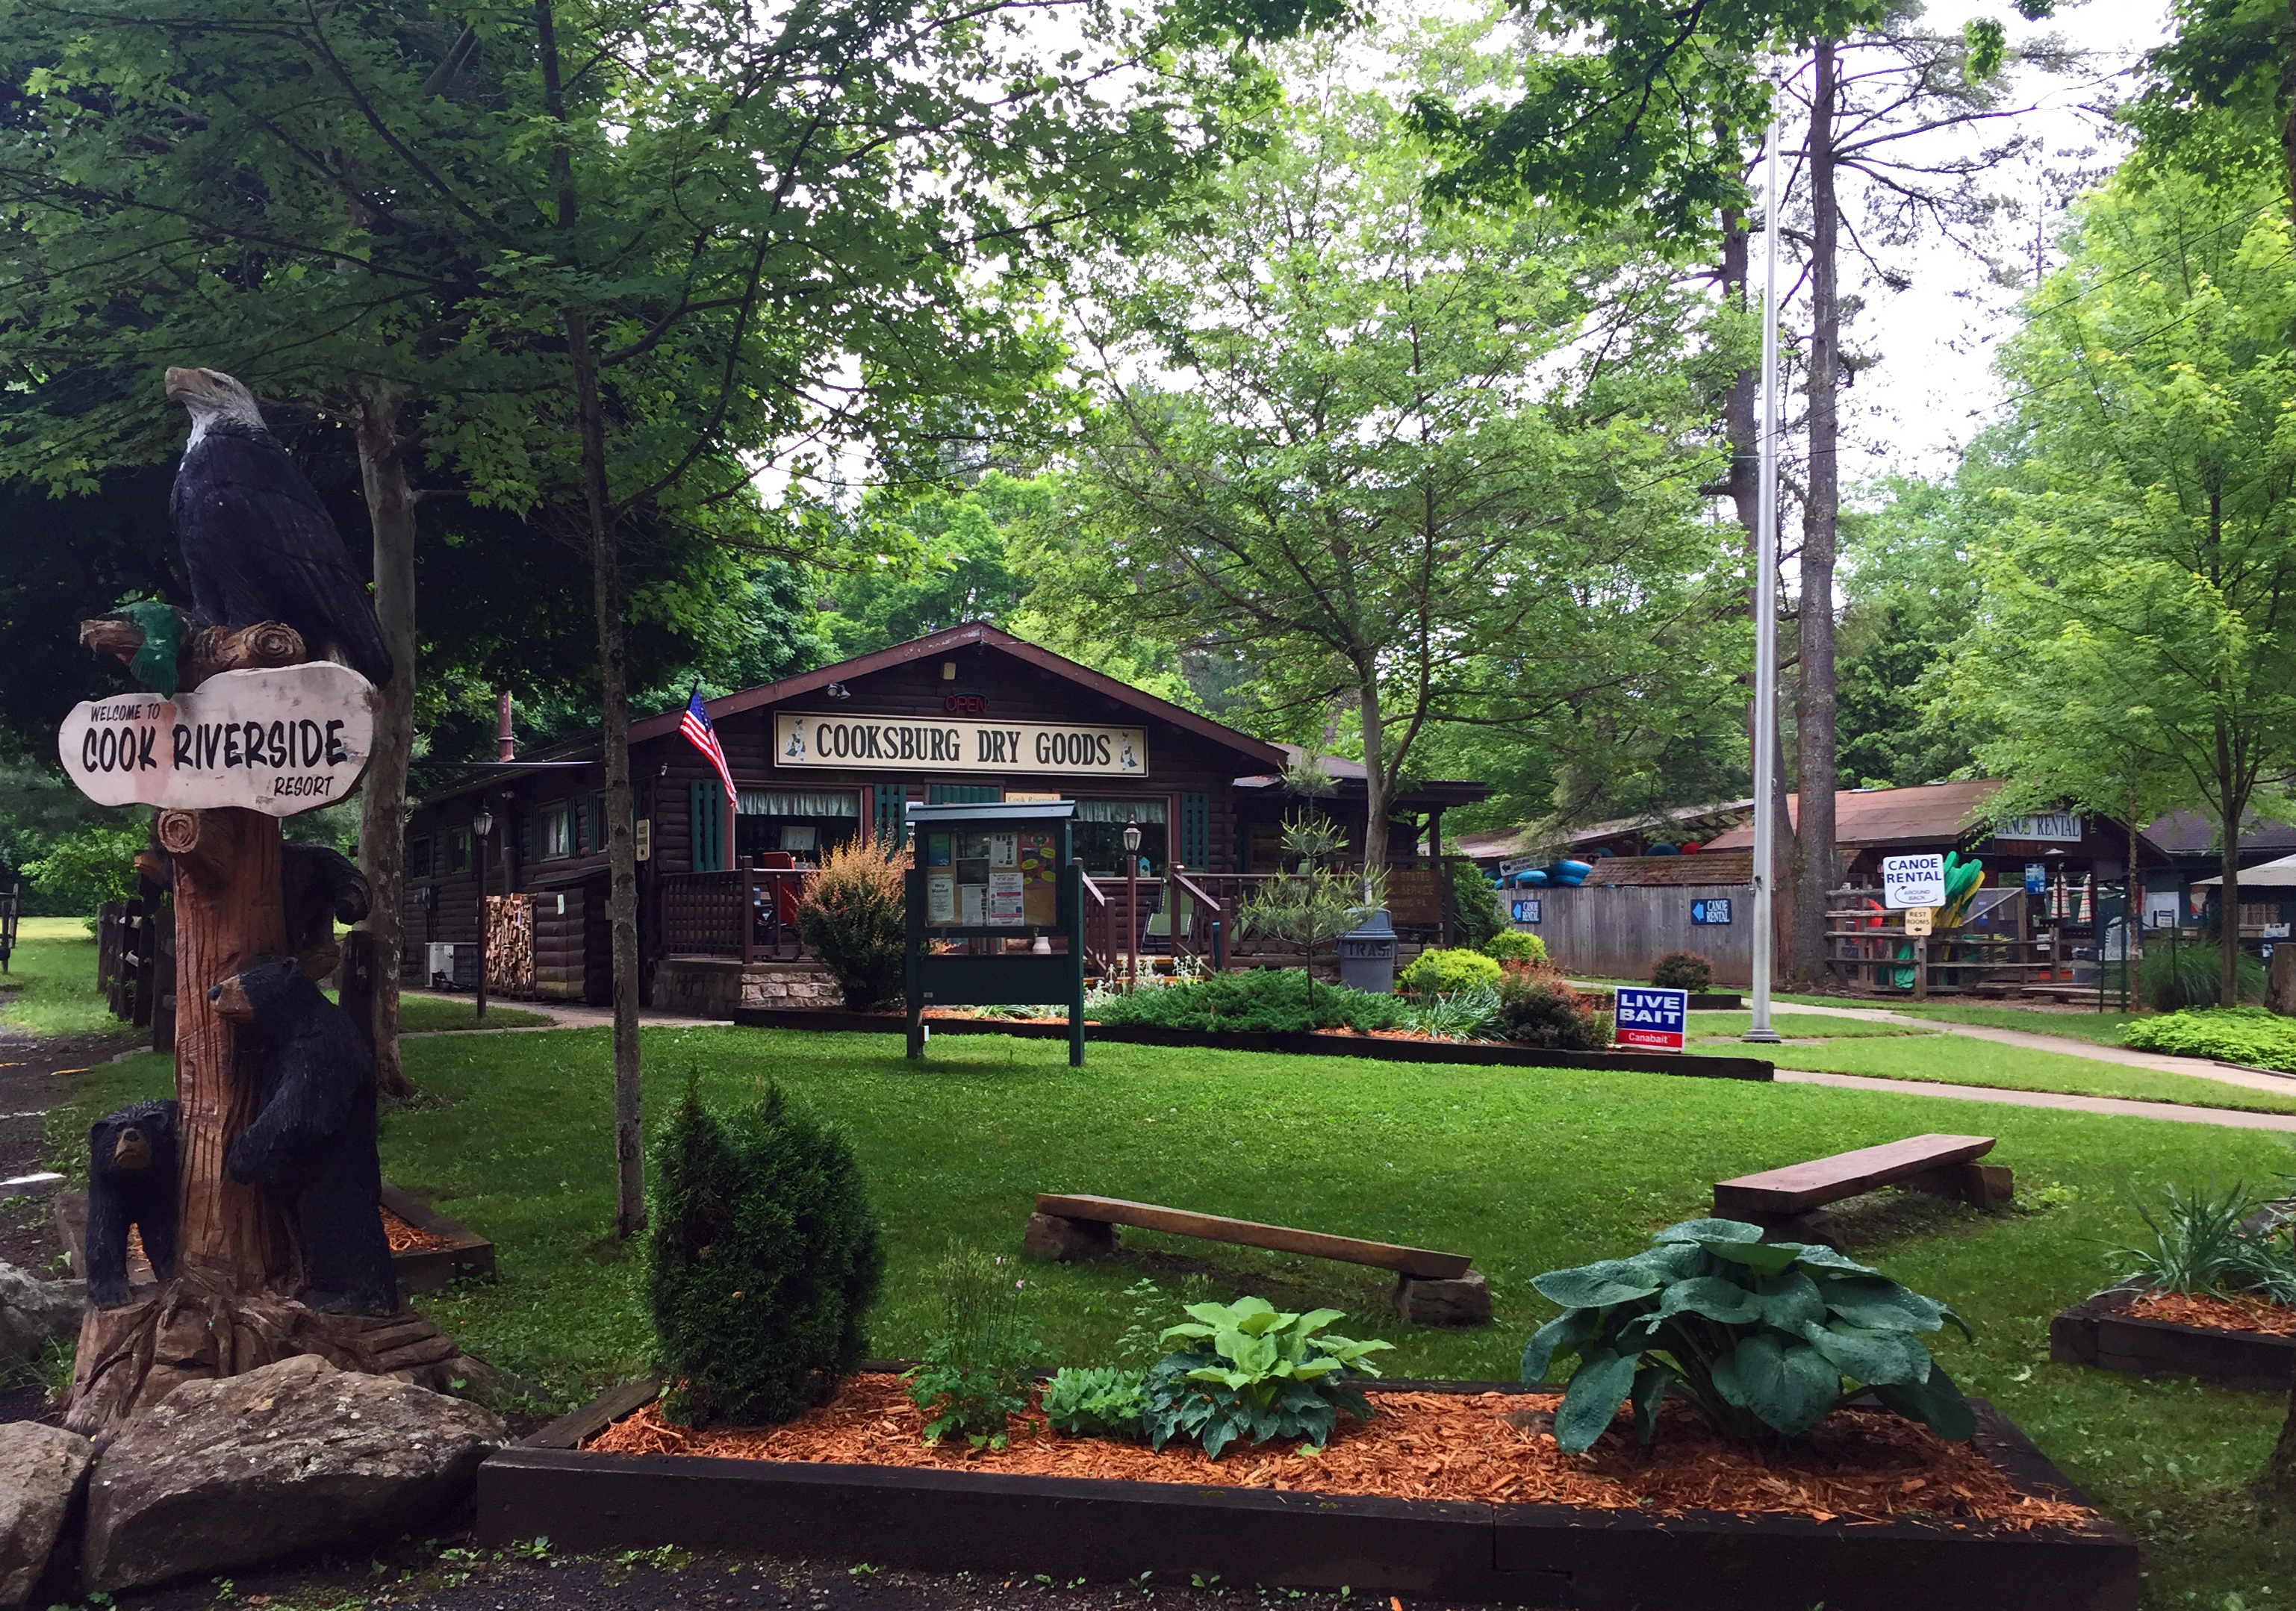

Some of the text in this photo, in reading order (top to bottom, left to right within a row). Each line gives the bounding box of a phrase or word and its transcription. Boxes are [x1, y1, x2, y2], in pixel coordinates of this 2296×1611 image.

[945, 695, 987, 713] OPEN
[90, 702, 161, 723] WELCOME TO
[81, 719, 348, 773] COOK RIVERSIDE
[815, 723, 1111, 766] COOKSBURG DRY GOODS
[273, 776, 334, 797] RESORT
[2037, 814, 2079, 837] RENTAL
[1888, 858, 1939, 871] CANOE
[1886, 870, 1942, 884] RENTAL
[1523, 901, 1539, 912] CANOE
[1707, 900, 1729, 912] CANOE
[1522, 911, 1540, 921] RENTAL
[1706, 911, 1730, 923] RENTAL
[1621, 994, 1680, 1010] LIVE
[1620, 1008, 1681, 1024] BAIT
[1628, 1032, 1668, 1043] Canabait
